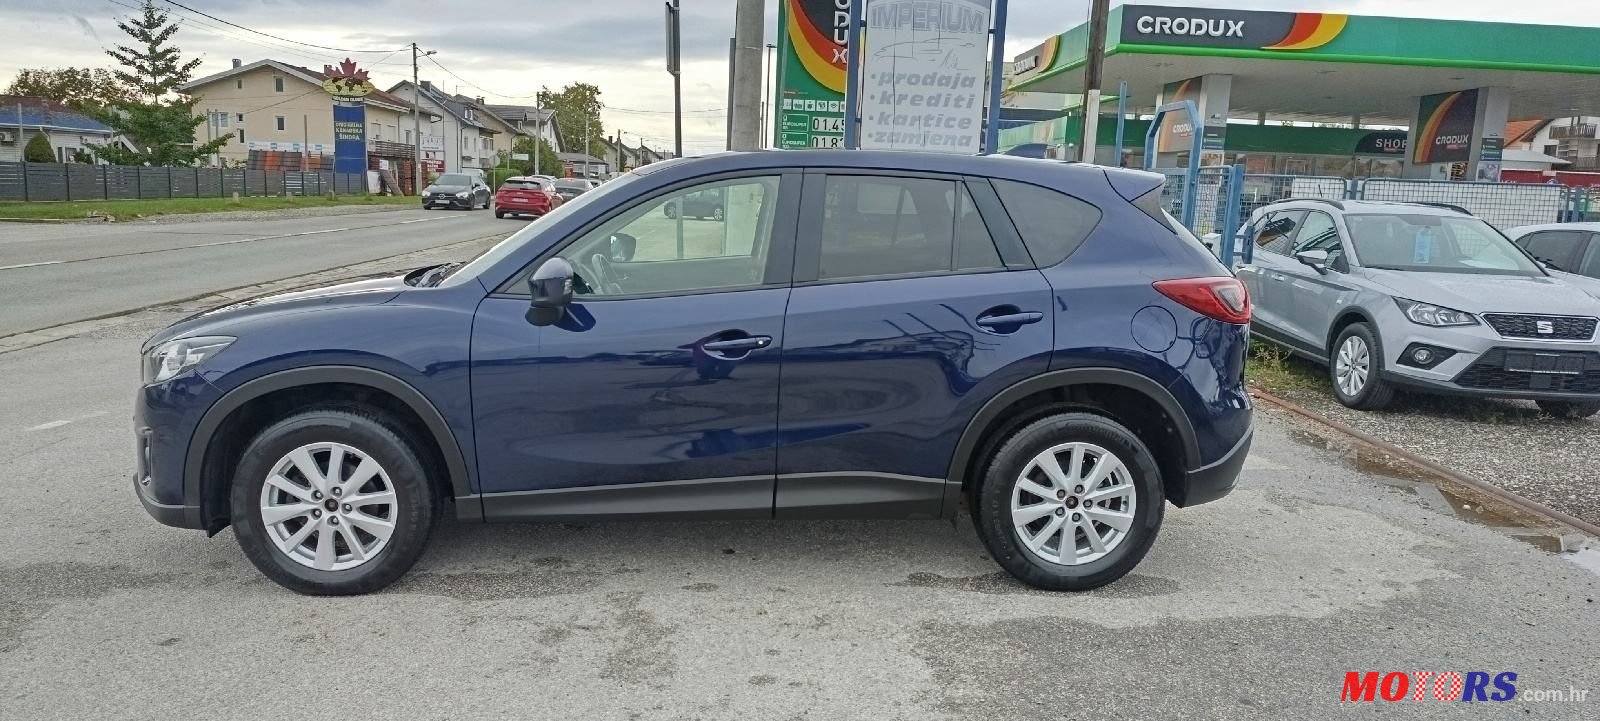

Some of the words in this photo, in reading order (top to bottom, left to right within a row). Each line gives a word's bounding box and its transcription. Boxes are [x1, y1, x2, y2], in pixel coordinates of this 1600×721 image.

[870, 3, 984, 34] IMPERIUM
[1136, 15, 1245, 38] CRODUX
[878, 72, 977, 90] prodaja
[878, 91, 976, 109] krediti
[876, 111, 972, 130] kartice
[1172, 122, 1193, 134] CRODU
[873, 131, 973, 147] zamjena
[1435, 133, 1470, 145] CRODUX
